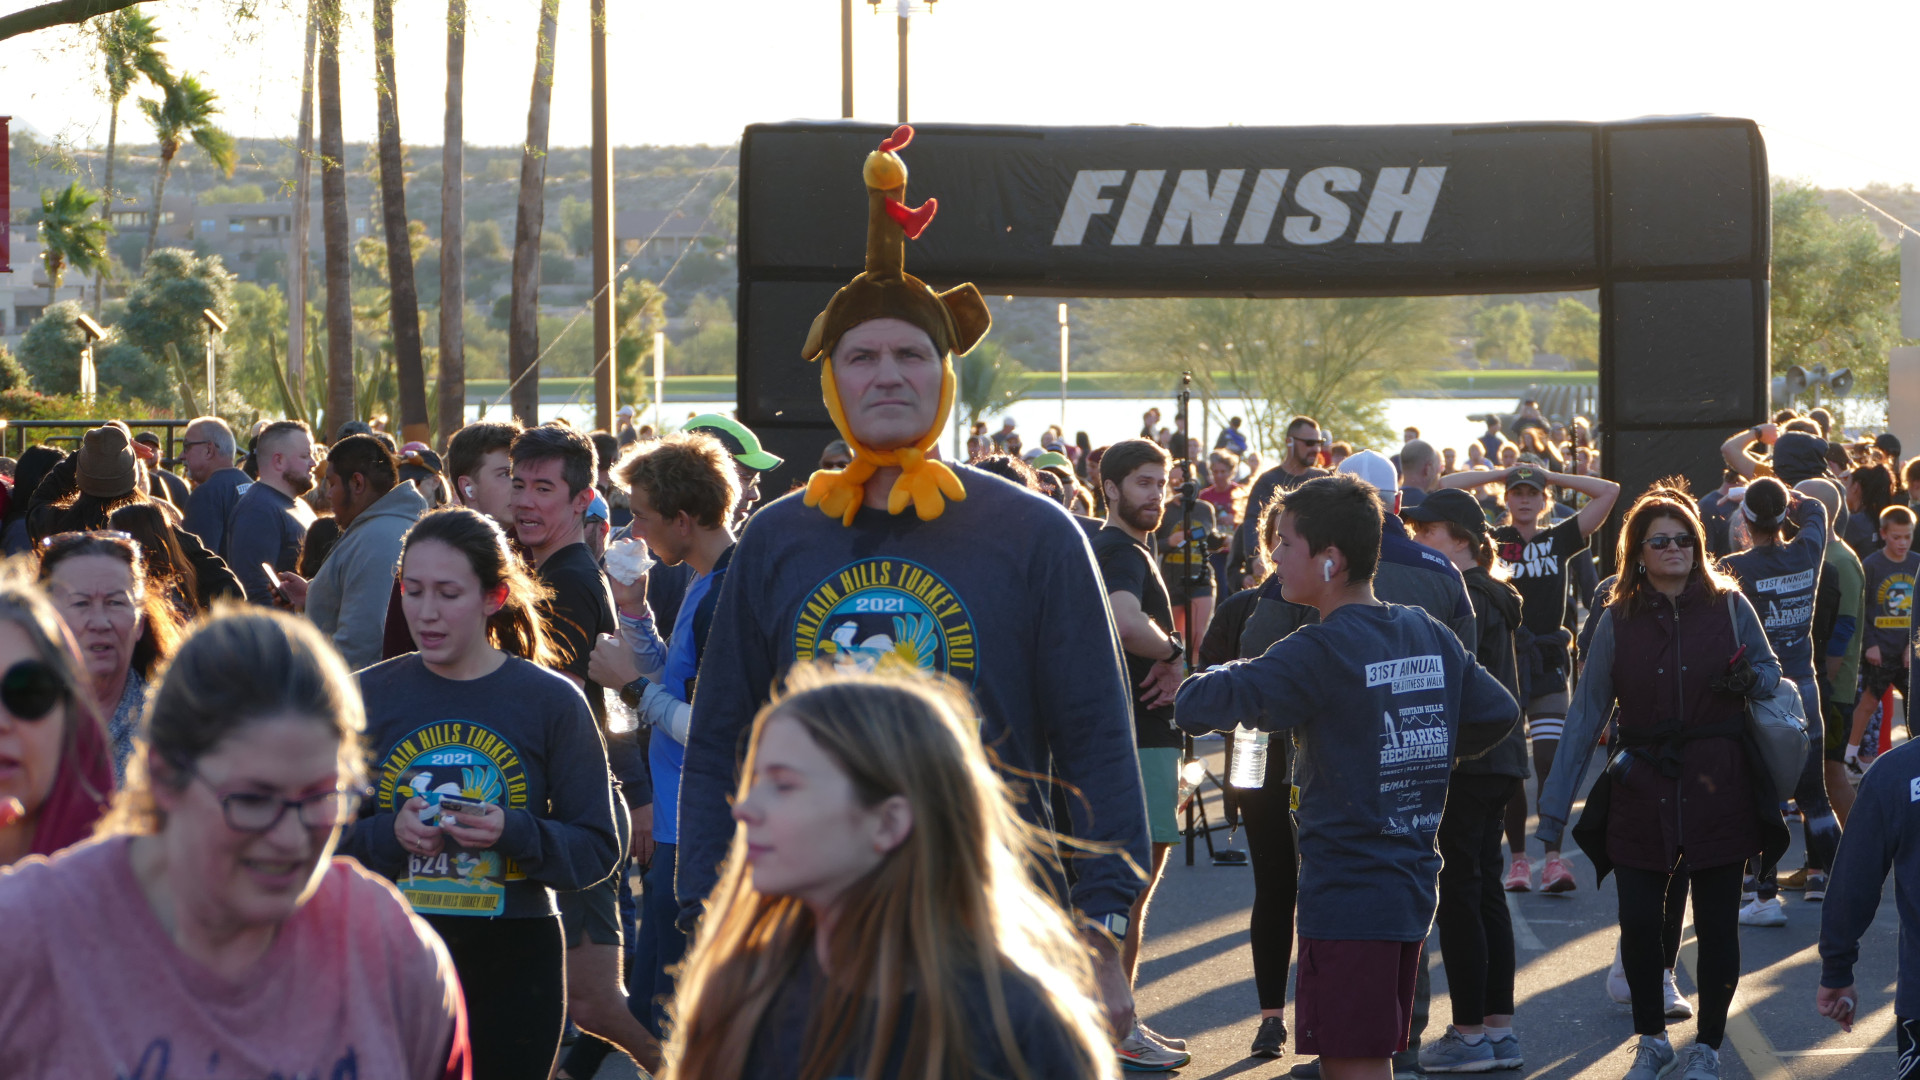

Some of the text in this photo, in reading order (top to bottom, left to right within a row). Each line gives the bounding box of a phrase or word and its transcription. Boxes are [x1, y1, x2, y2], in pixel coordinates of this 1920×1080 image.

[1052, 166, 1447, 246] FINISH
[1502, 537, 1554, 562] BOW
[1500, 555, 1559, 579] OWN
[1758, 571, 1811, 589] 31ST ANNUAL
[855, 598, 904, 612] 2021
[1781, 606, 1809, 618] PARKS
[796, 561, 975, 670] OUNTAIN HILLS TURKEY TROT
[1369, 663, 1397, 682] 31ST
[1426, 677, 1443, 687] WALK
[1398, 704, 1444, 716] FOUNTAIN HILLS
[417, 723, 461, 749] HILLS
[466, 725, 519, 771] TURKEY
[1402, 727, 1443, 748] PARKS
[431, 753, 473, 765] 2021
[1380, 743, 1448, 765] RECREATION
[1380, 779, 1411, 793] RE/MAX
